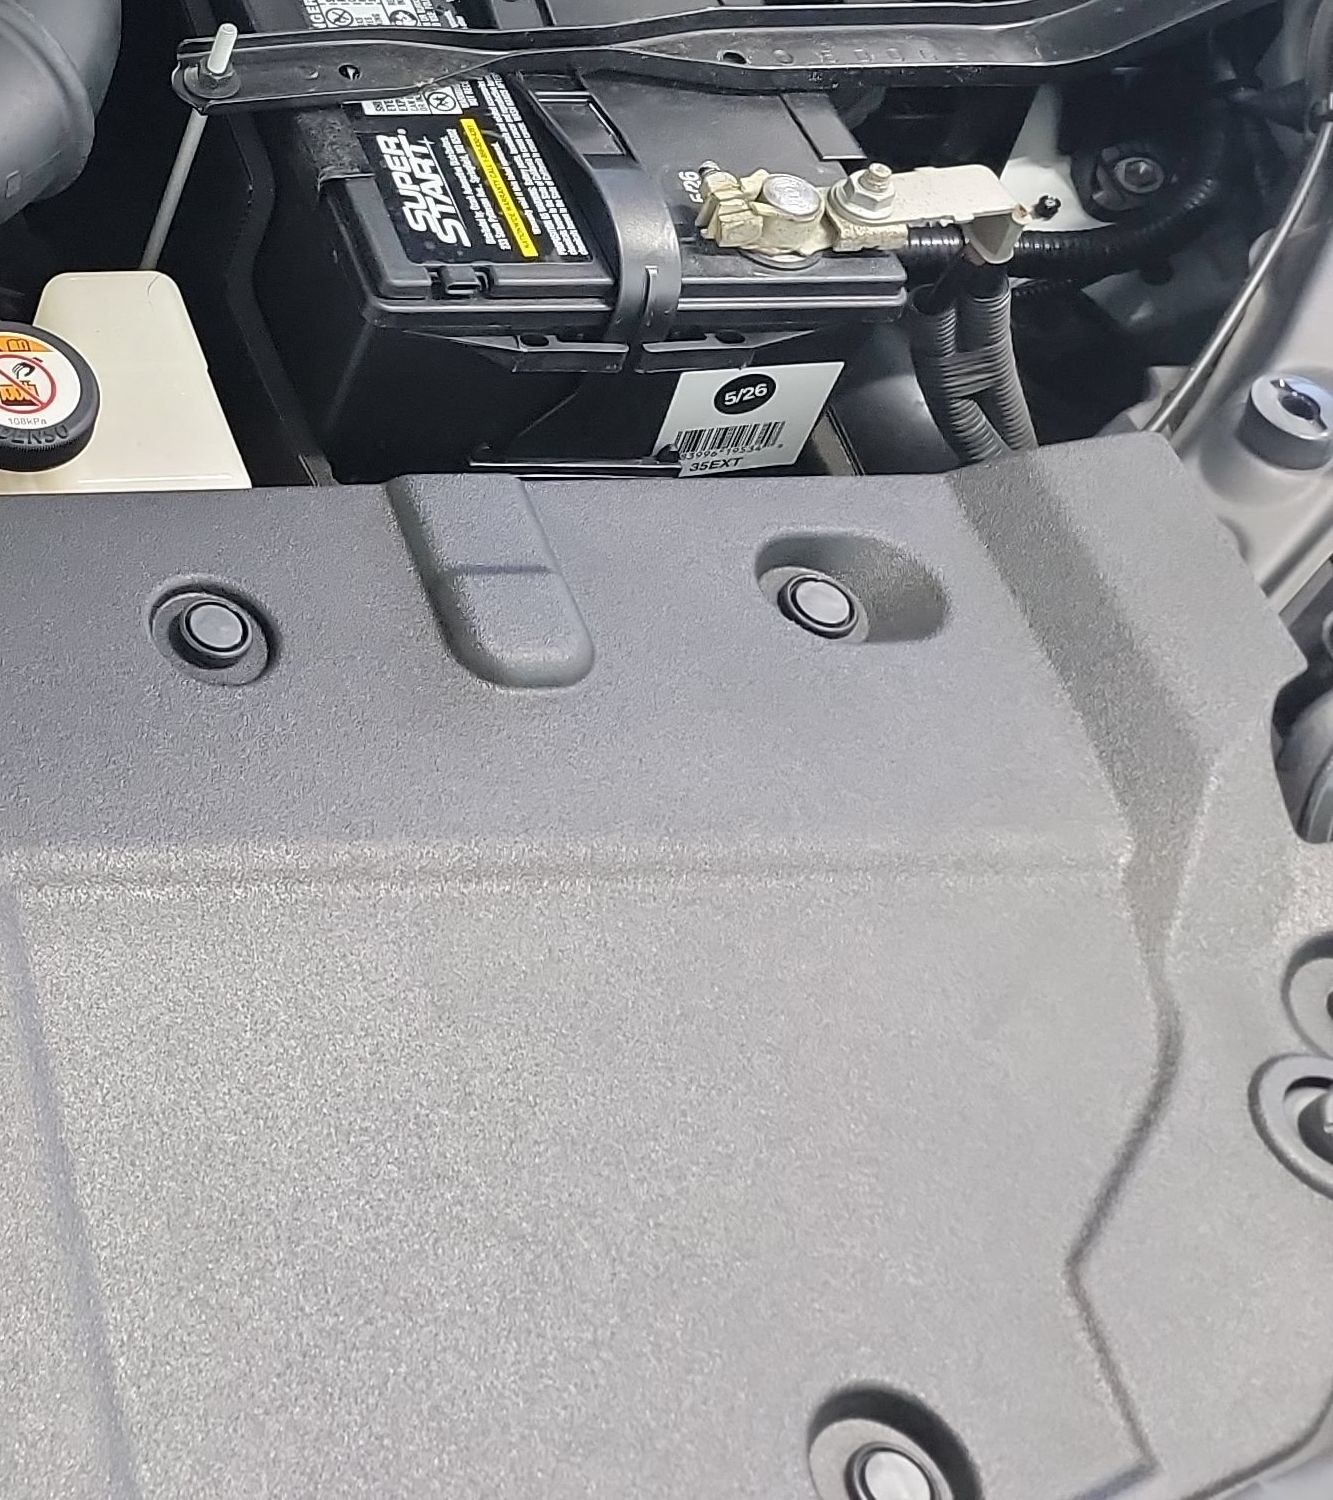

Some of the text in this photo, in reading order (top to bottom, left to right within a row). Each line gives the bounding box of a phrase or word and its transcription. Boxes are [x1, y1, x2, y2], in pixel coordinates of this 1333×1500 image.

[376, 134, 434, 232] SUPER
[398, 132, 471, 247] START
[724, 383, 768, 406] 5/26
[8, 418, 47, 426] 108kPa
[689, 457, 743, 472] 35EXT
